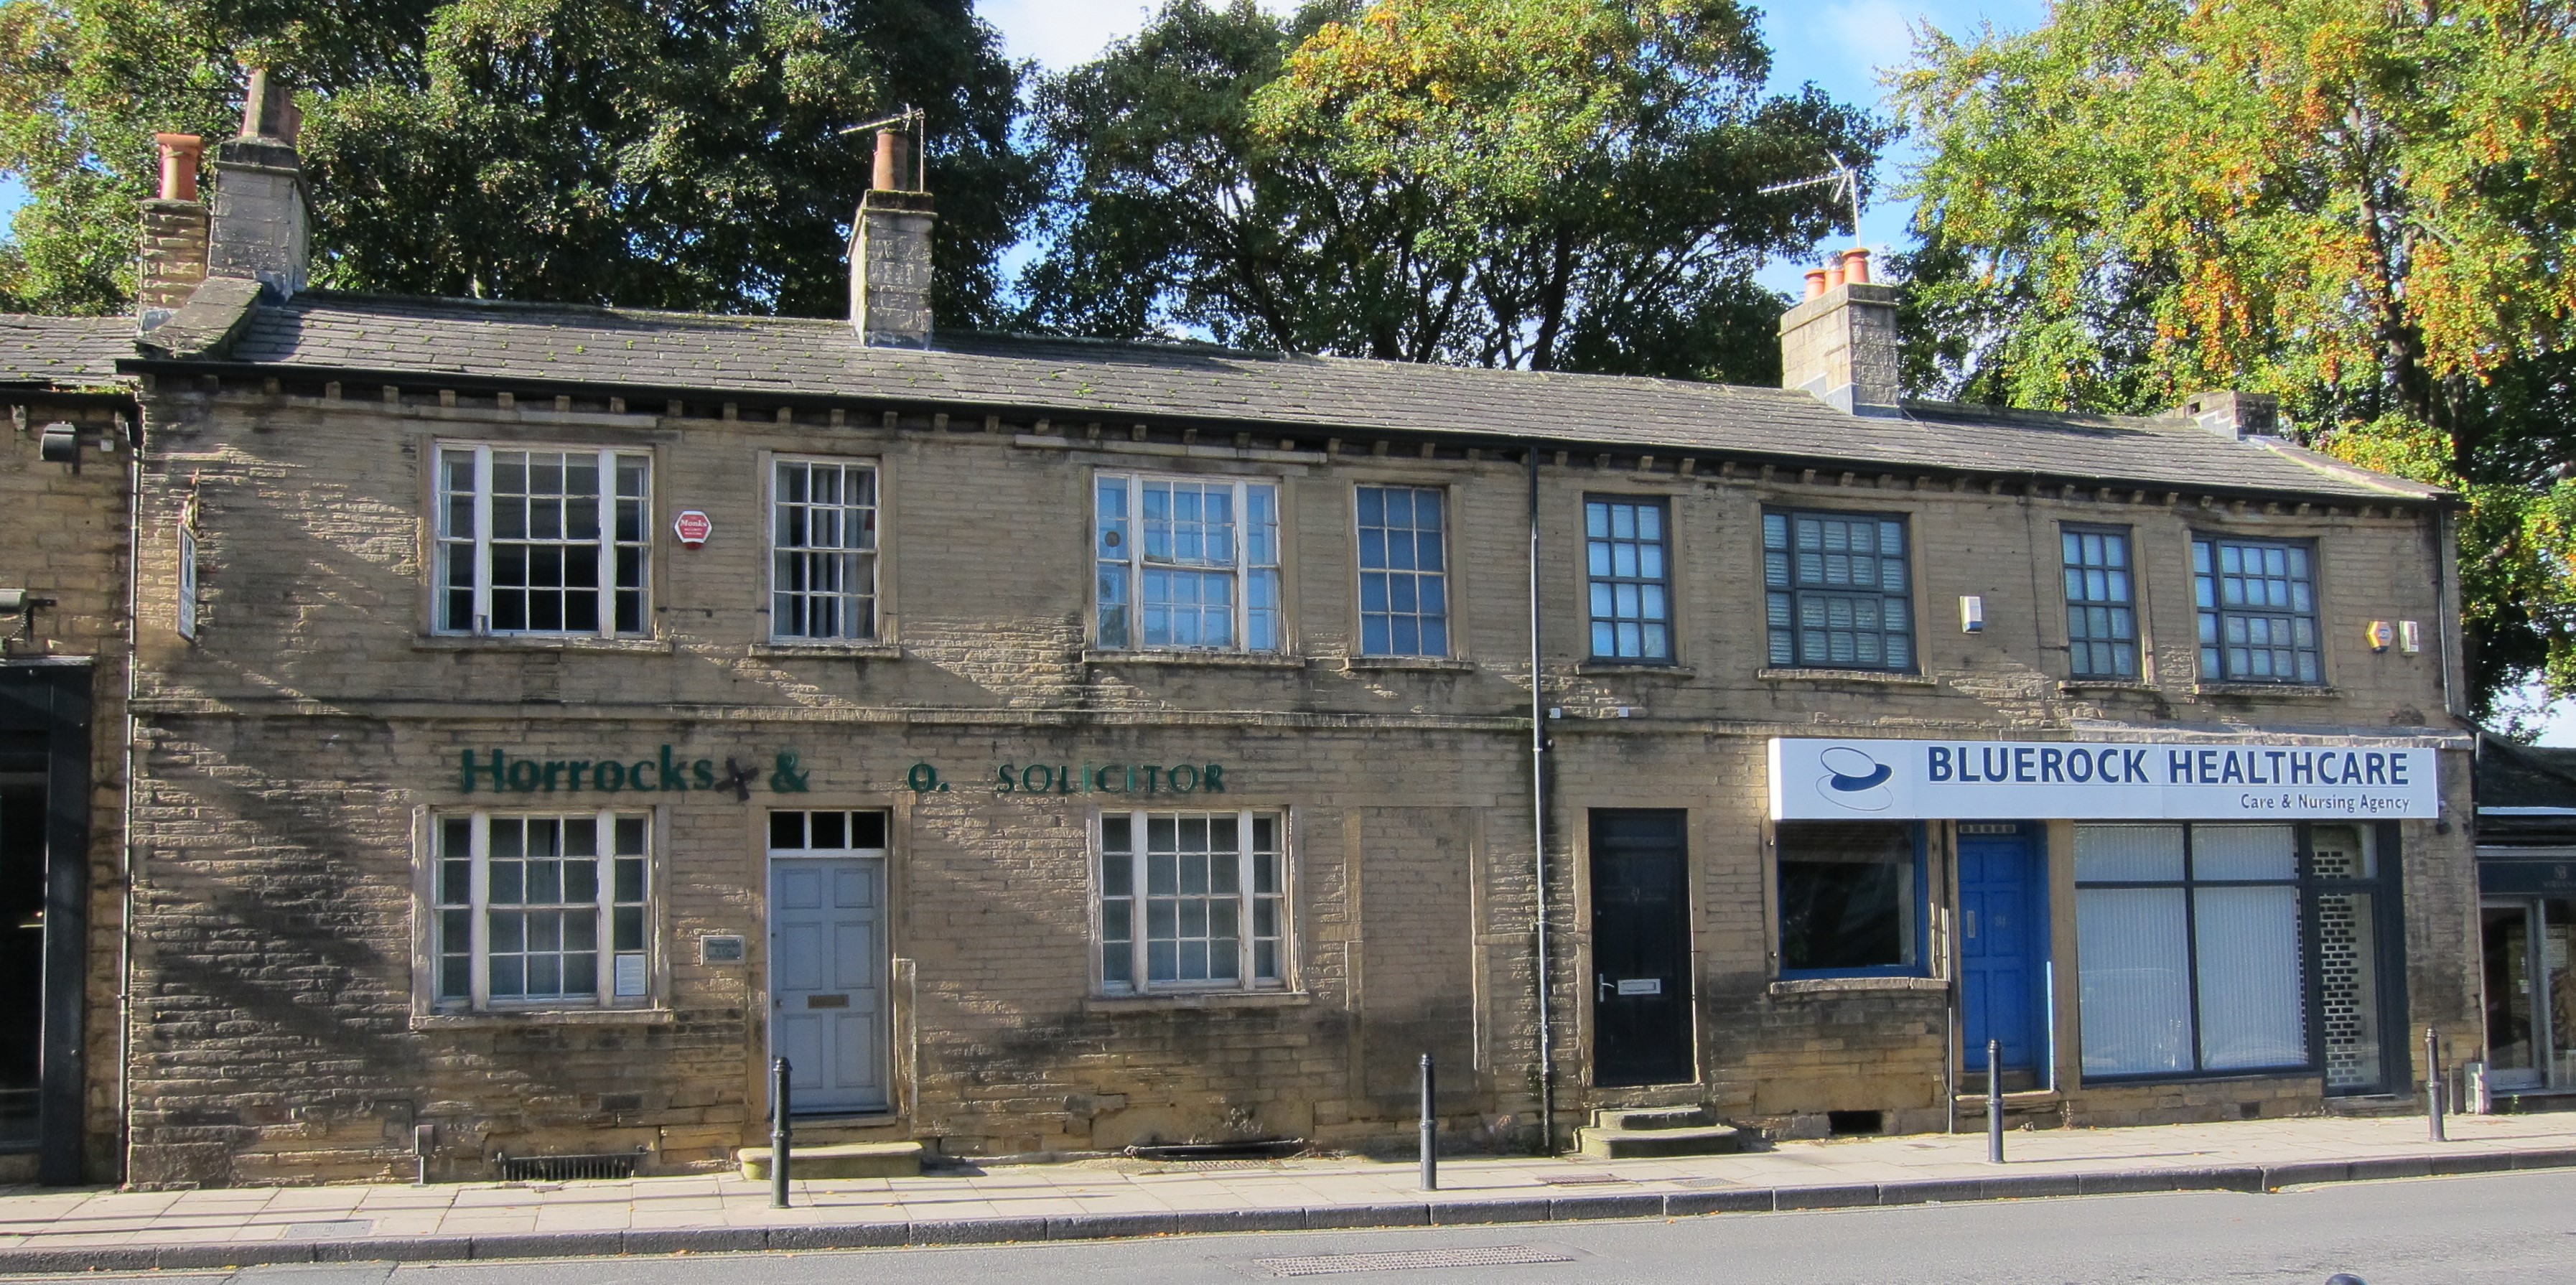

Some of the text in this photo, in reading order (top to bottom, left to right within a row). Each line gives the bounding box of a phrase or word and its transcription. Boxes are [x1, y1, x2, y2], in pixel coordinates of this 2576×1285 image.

[462, 744, 714, 793] Horrocks
[770, 748, 809, 793] &
[996, 762, 1225, 795] SOLICITOR
[1928, 746, 2410, 785] BLUEROCK HEALTHCARE
[2241, 793, 2410, 814] Care & Nursing Agency
